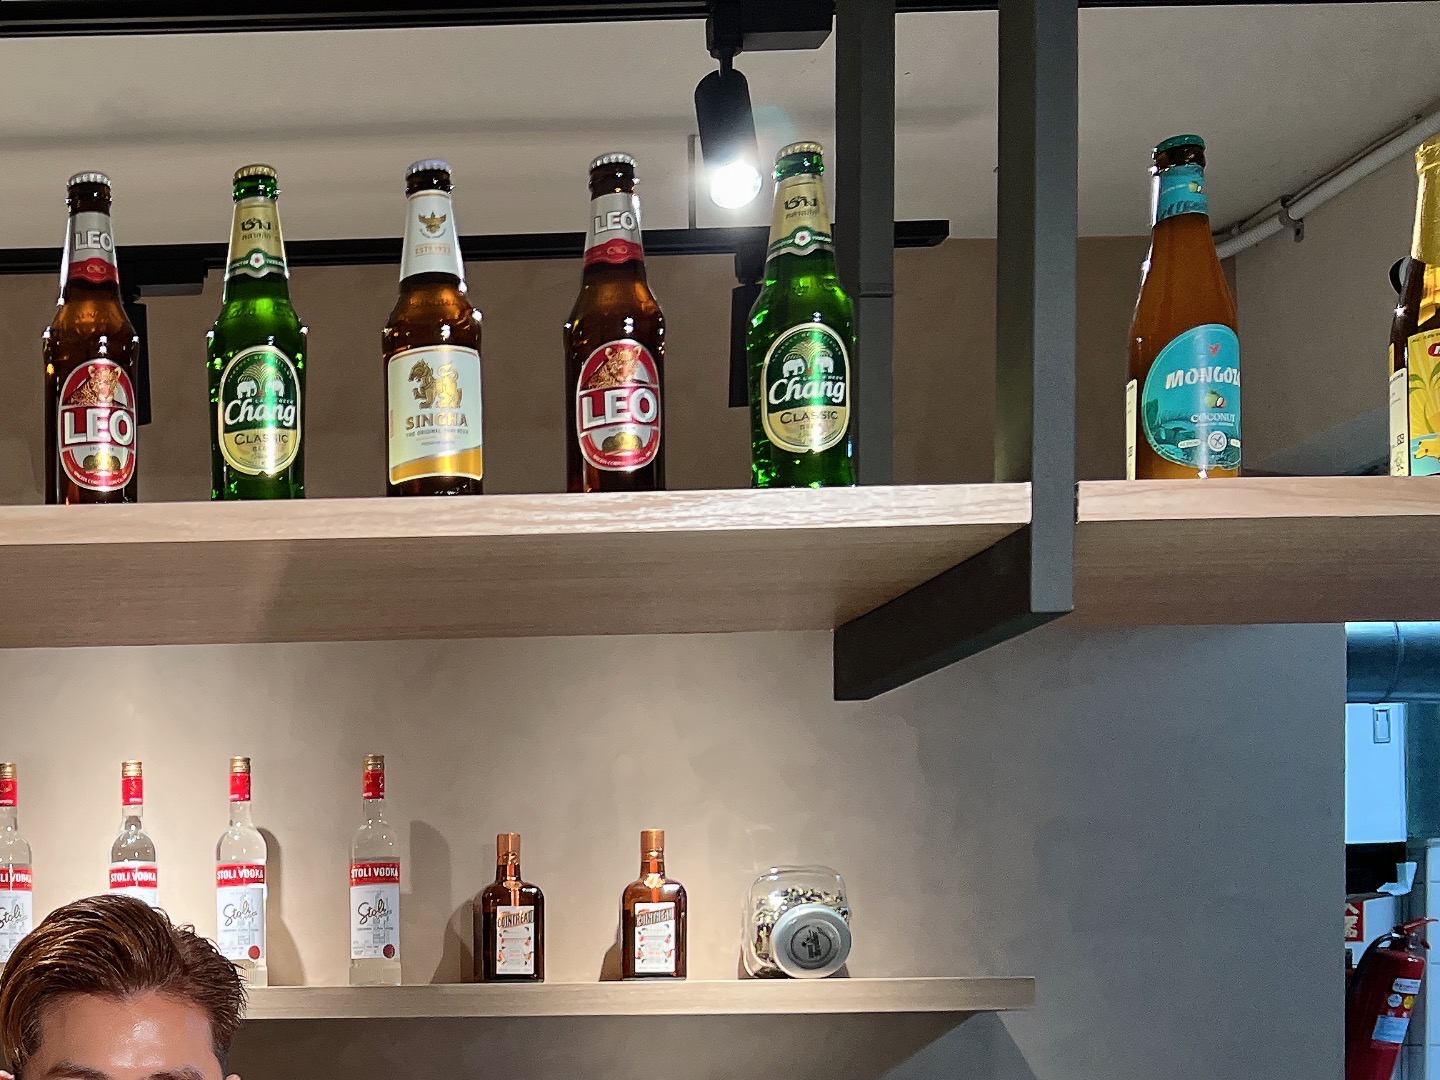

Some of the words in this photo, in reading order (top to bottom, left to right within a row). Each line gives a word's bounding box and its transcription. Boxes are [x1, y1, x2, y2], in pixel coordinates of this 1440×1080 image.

[594, 211, 636, 235] LEO
[75, 230, 113, 252] LEO
[769, 377, 845, 405] Chang
[224, 399, 296, 427] Chang
[581, 388, 658, 429] LEO
[780, 410, 838, 425] CLASSIC
[64, 408, 134, 446] LEO
[405, 413, 468, 431] SINGHA
[1191, 413, 1236, 423] COCONUT
[234, 433, 289, 445] CLASIC
[10, 872, 32, 884] VODKA
[111, 872, 131, 882] STOLI
[132, 871, 157, 882] VODKA
[217, 869, 236, 880] STOLI
[238, 868, 264, 879] VODKA
[351, 868, 372, 878] STOLI
[373, 867, 399, 878] VODKA
[497, 909, 534, 928] COINTREAU
[635, 908, 674, 927] COINTREAU
